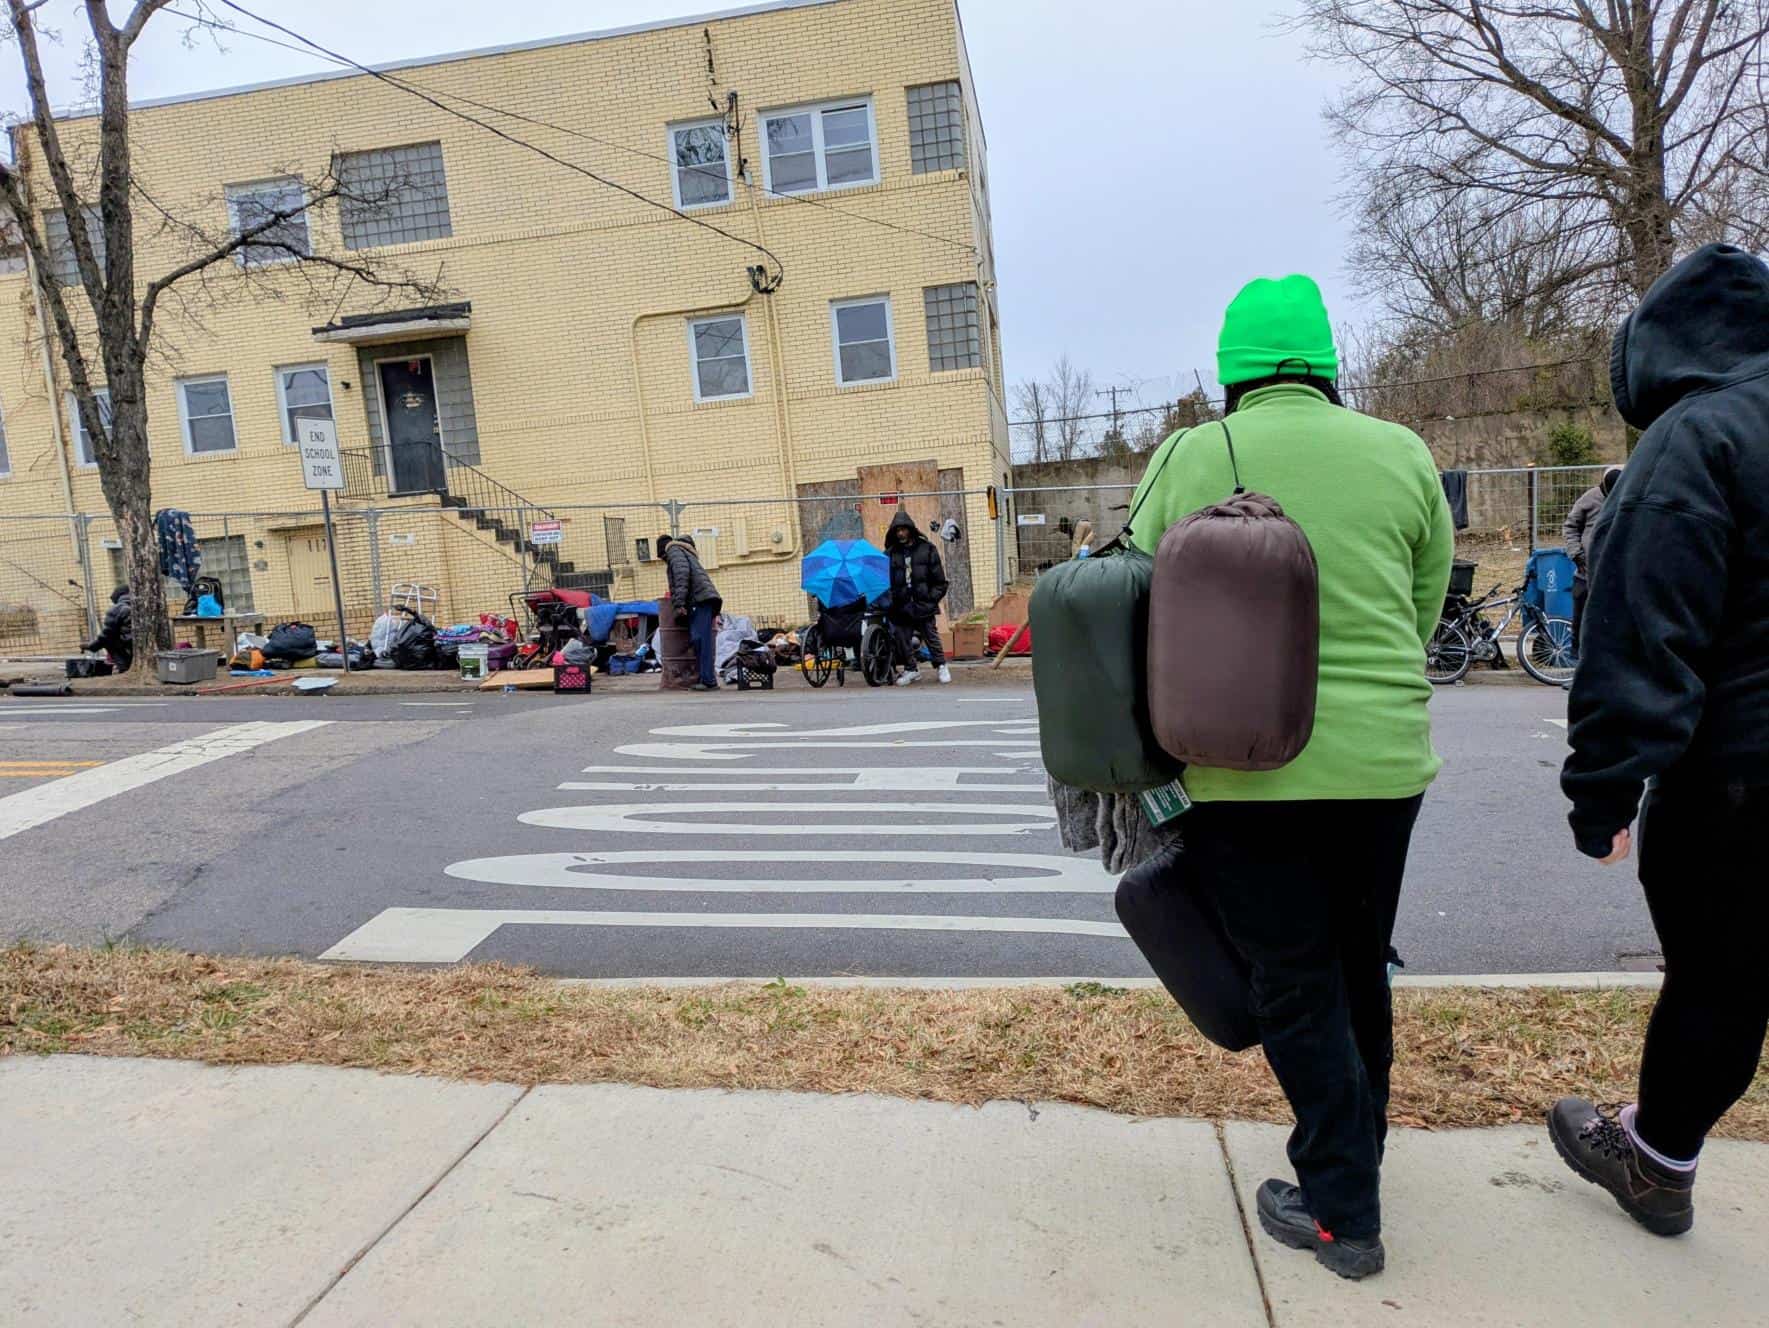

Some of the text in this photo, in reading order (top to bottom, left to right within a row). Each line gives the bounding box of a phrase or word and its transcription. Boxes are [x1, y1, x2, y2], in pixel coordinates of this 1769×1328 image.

[310, 430, 325, 442] END
[305, 448, 336, 460] SCHOOL
[312, 465, 333, 477] ZONE
